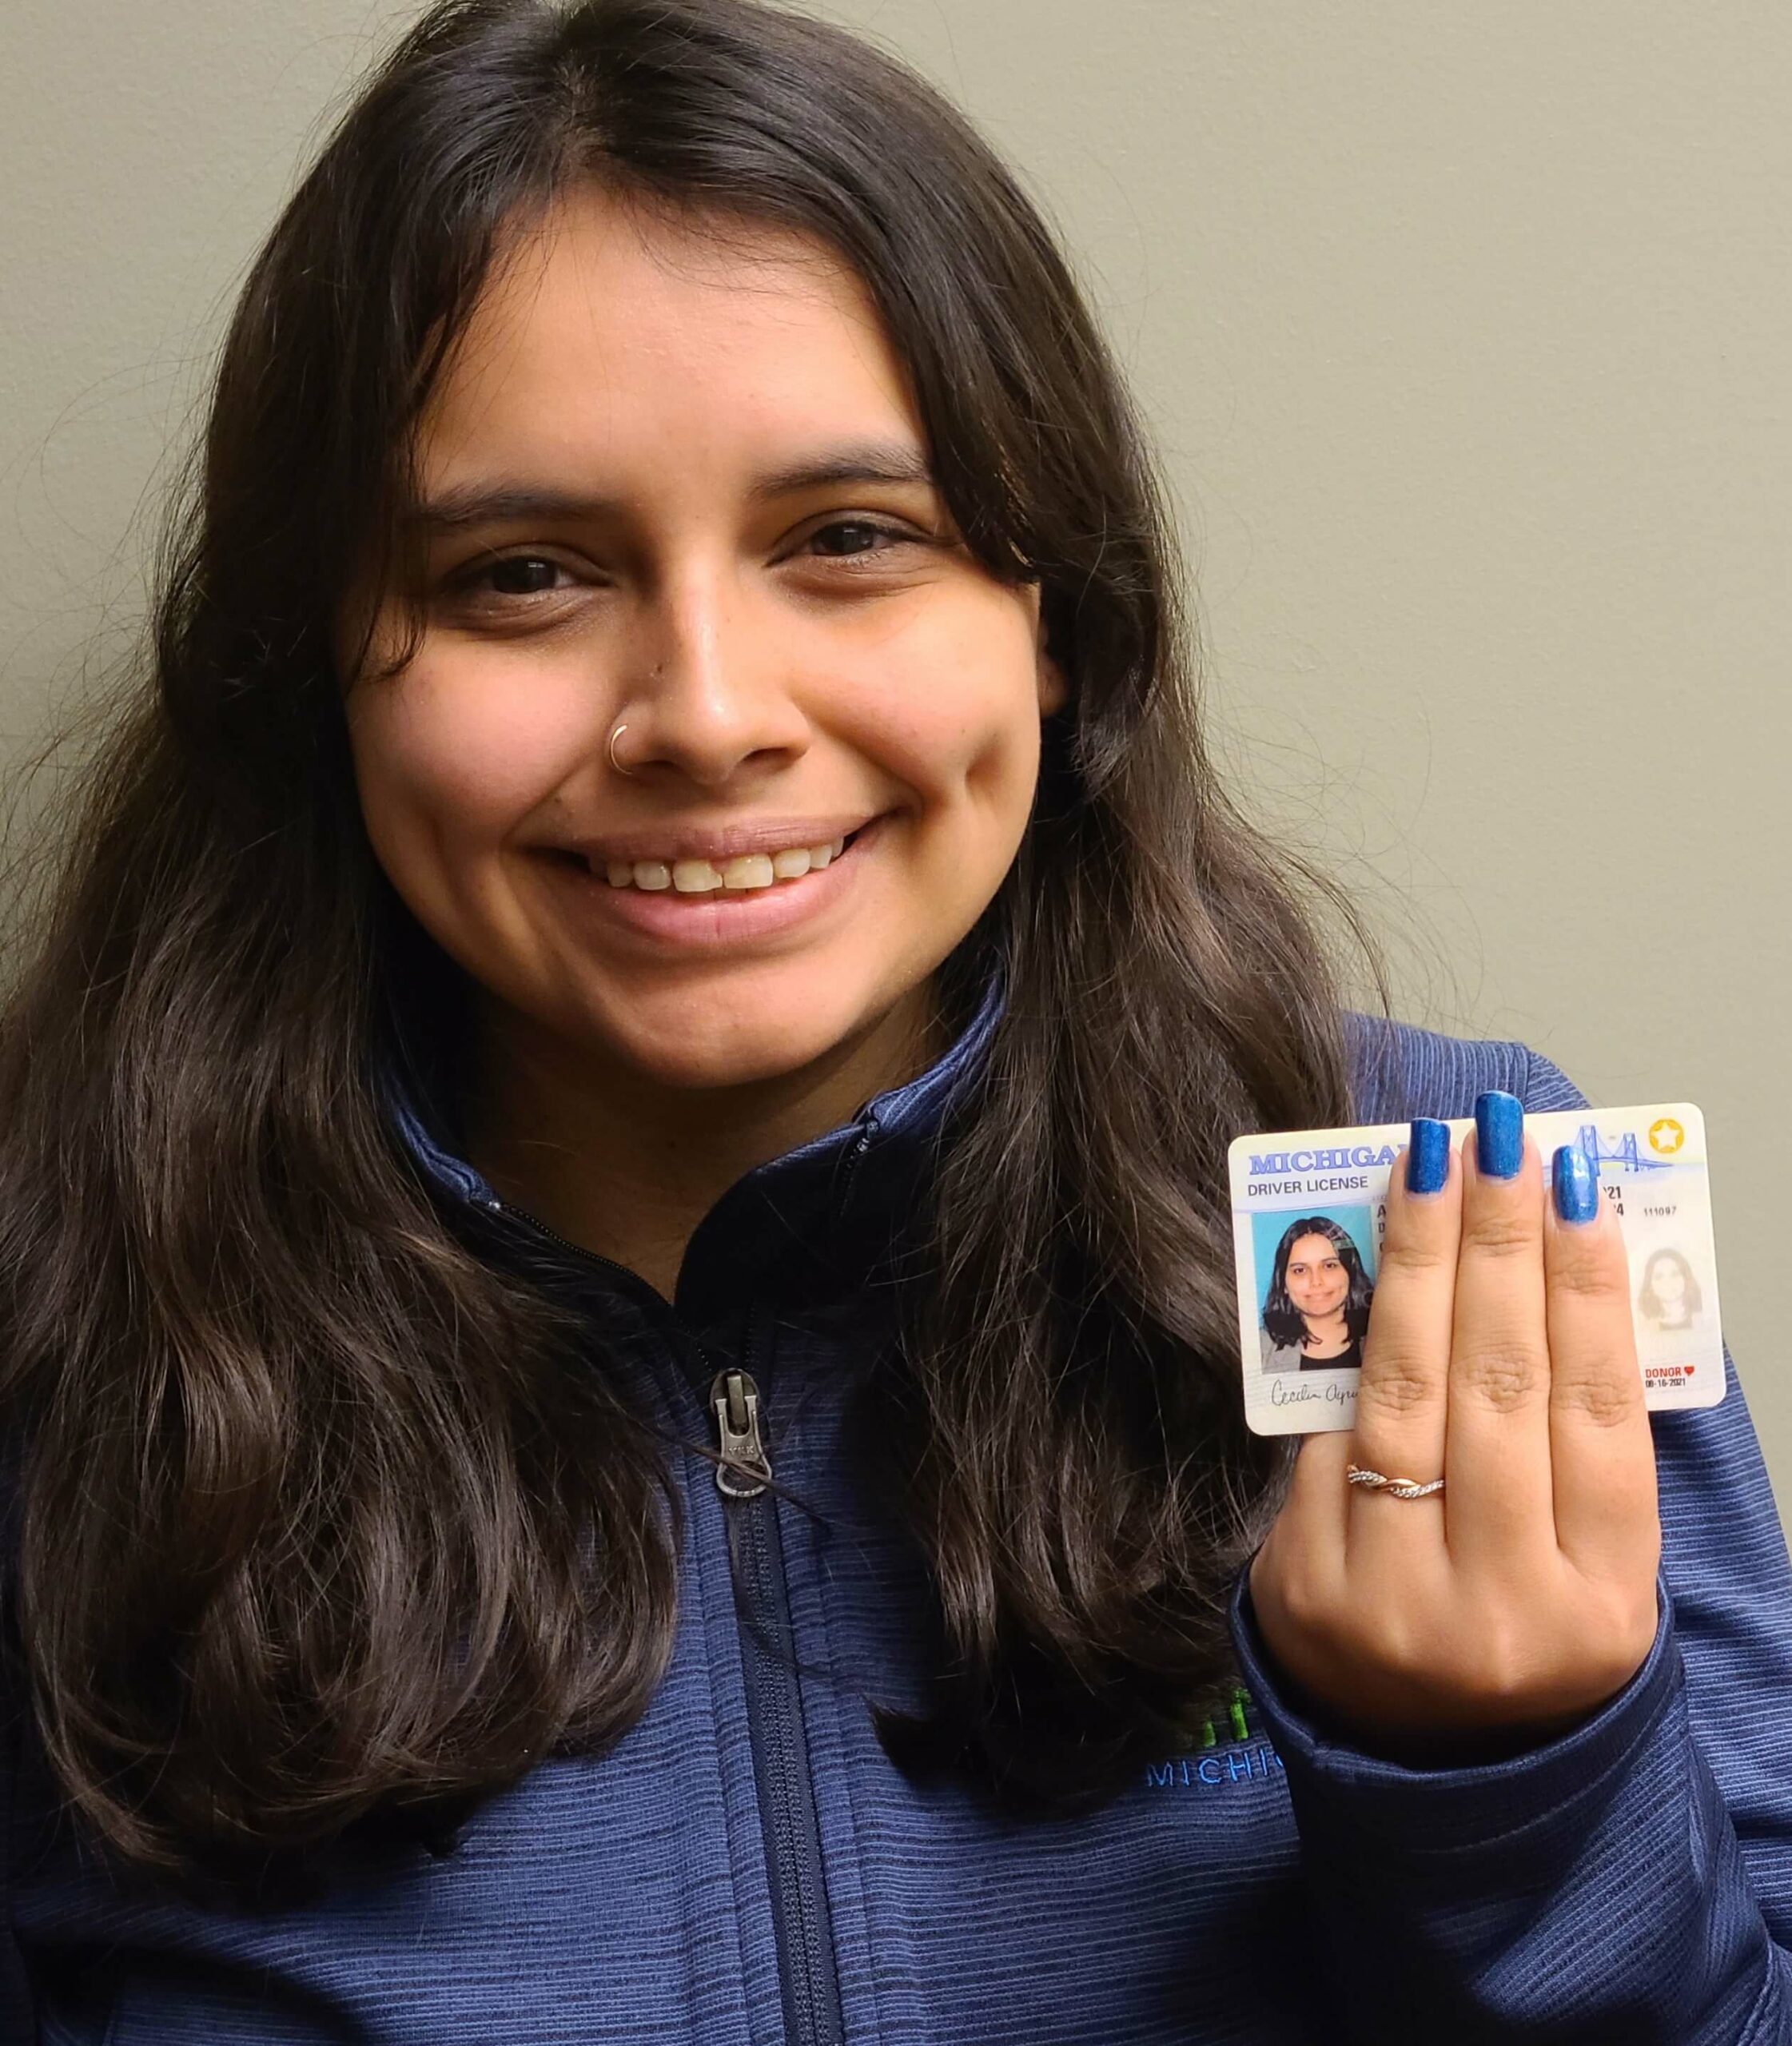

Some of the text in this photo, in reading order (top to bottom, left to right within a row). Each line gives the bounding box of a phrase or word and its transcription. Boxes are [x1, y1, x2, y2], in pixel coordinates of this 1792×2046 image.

[1248, 1144, 1410, 1176] MICHIGA
[1248, 1176, 1368, 1196] DRIVER LICENSE
[1603, 1185, 1622, 1200] 21
[1645, 1366, 1682, 1379] DONOR
